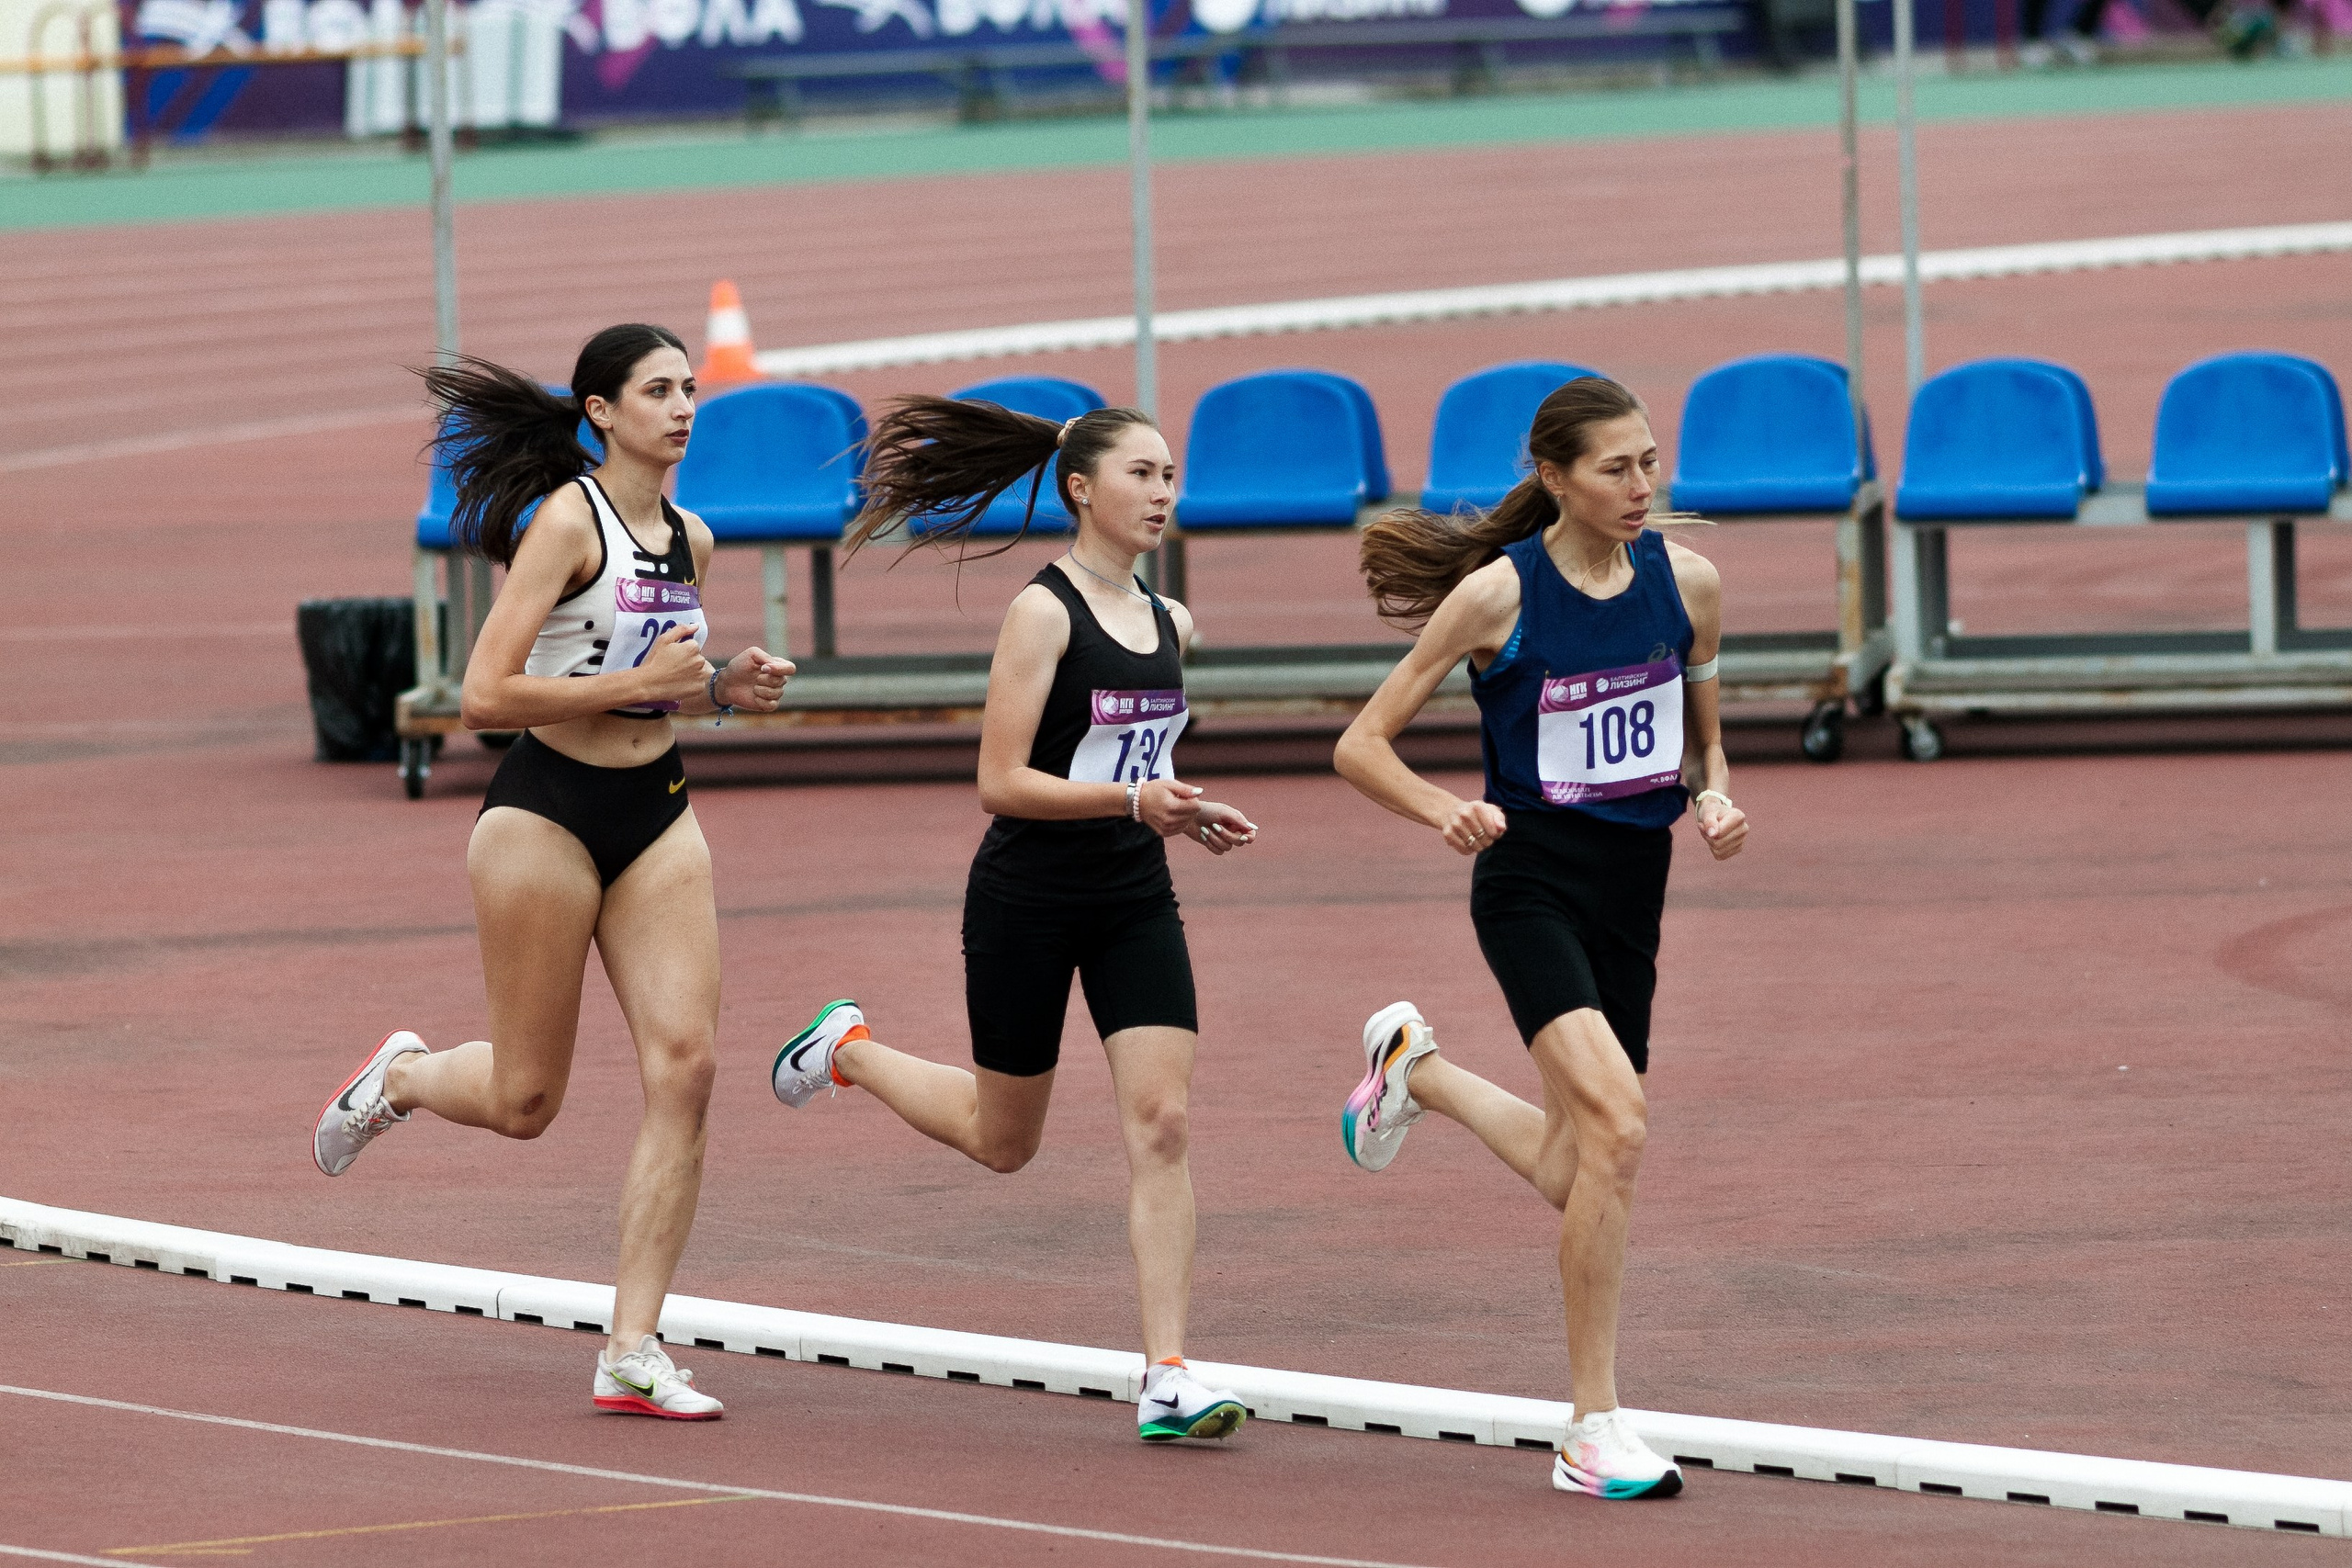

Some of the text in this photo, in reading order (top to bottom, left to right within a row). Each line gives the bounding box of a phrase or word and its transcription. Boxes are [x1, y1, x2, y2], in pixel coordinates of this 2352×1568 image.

[1610, 677, 1648, 690] ЛИЗИНГ
[1149, 703, 1175, 711] ЛИЗИНГ
[1579, 700, 1656, 770] 108
